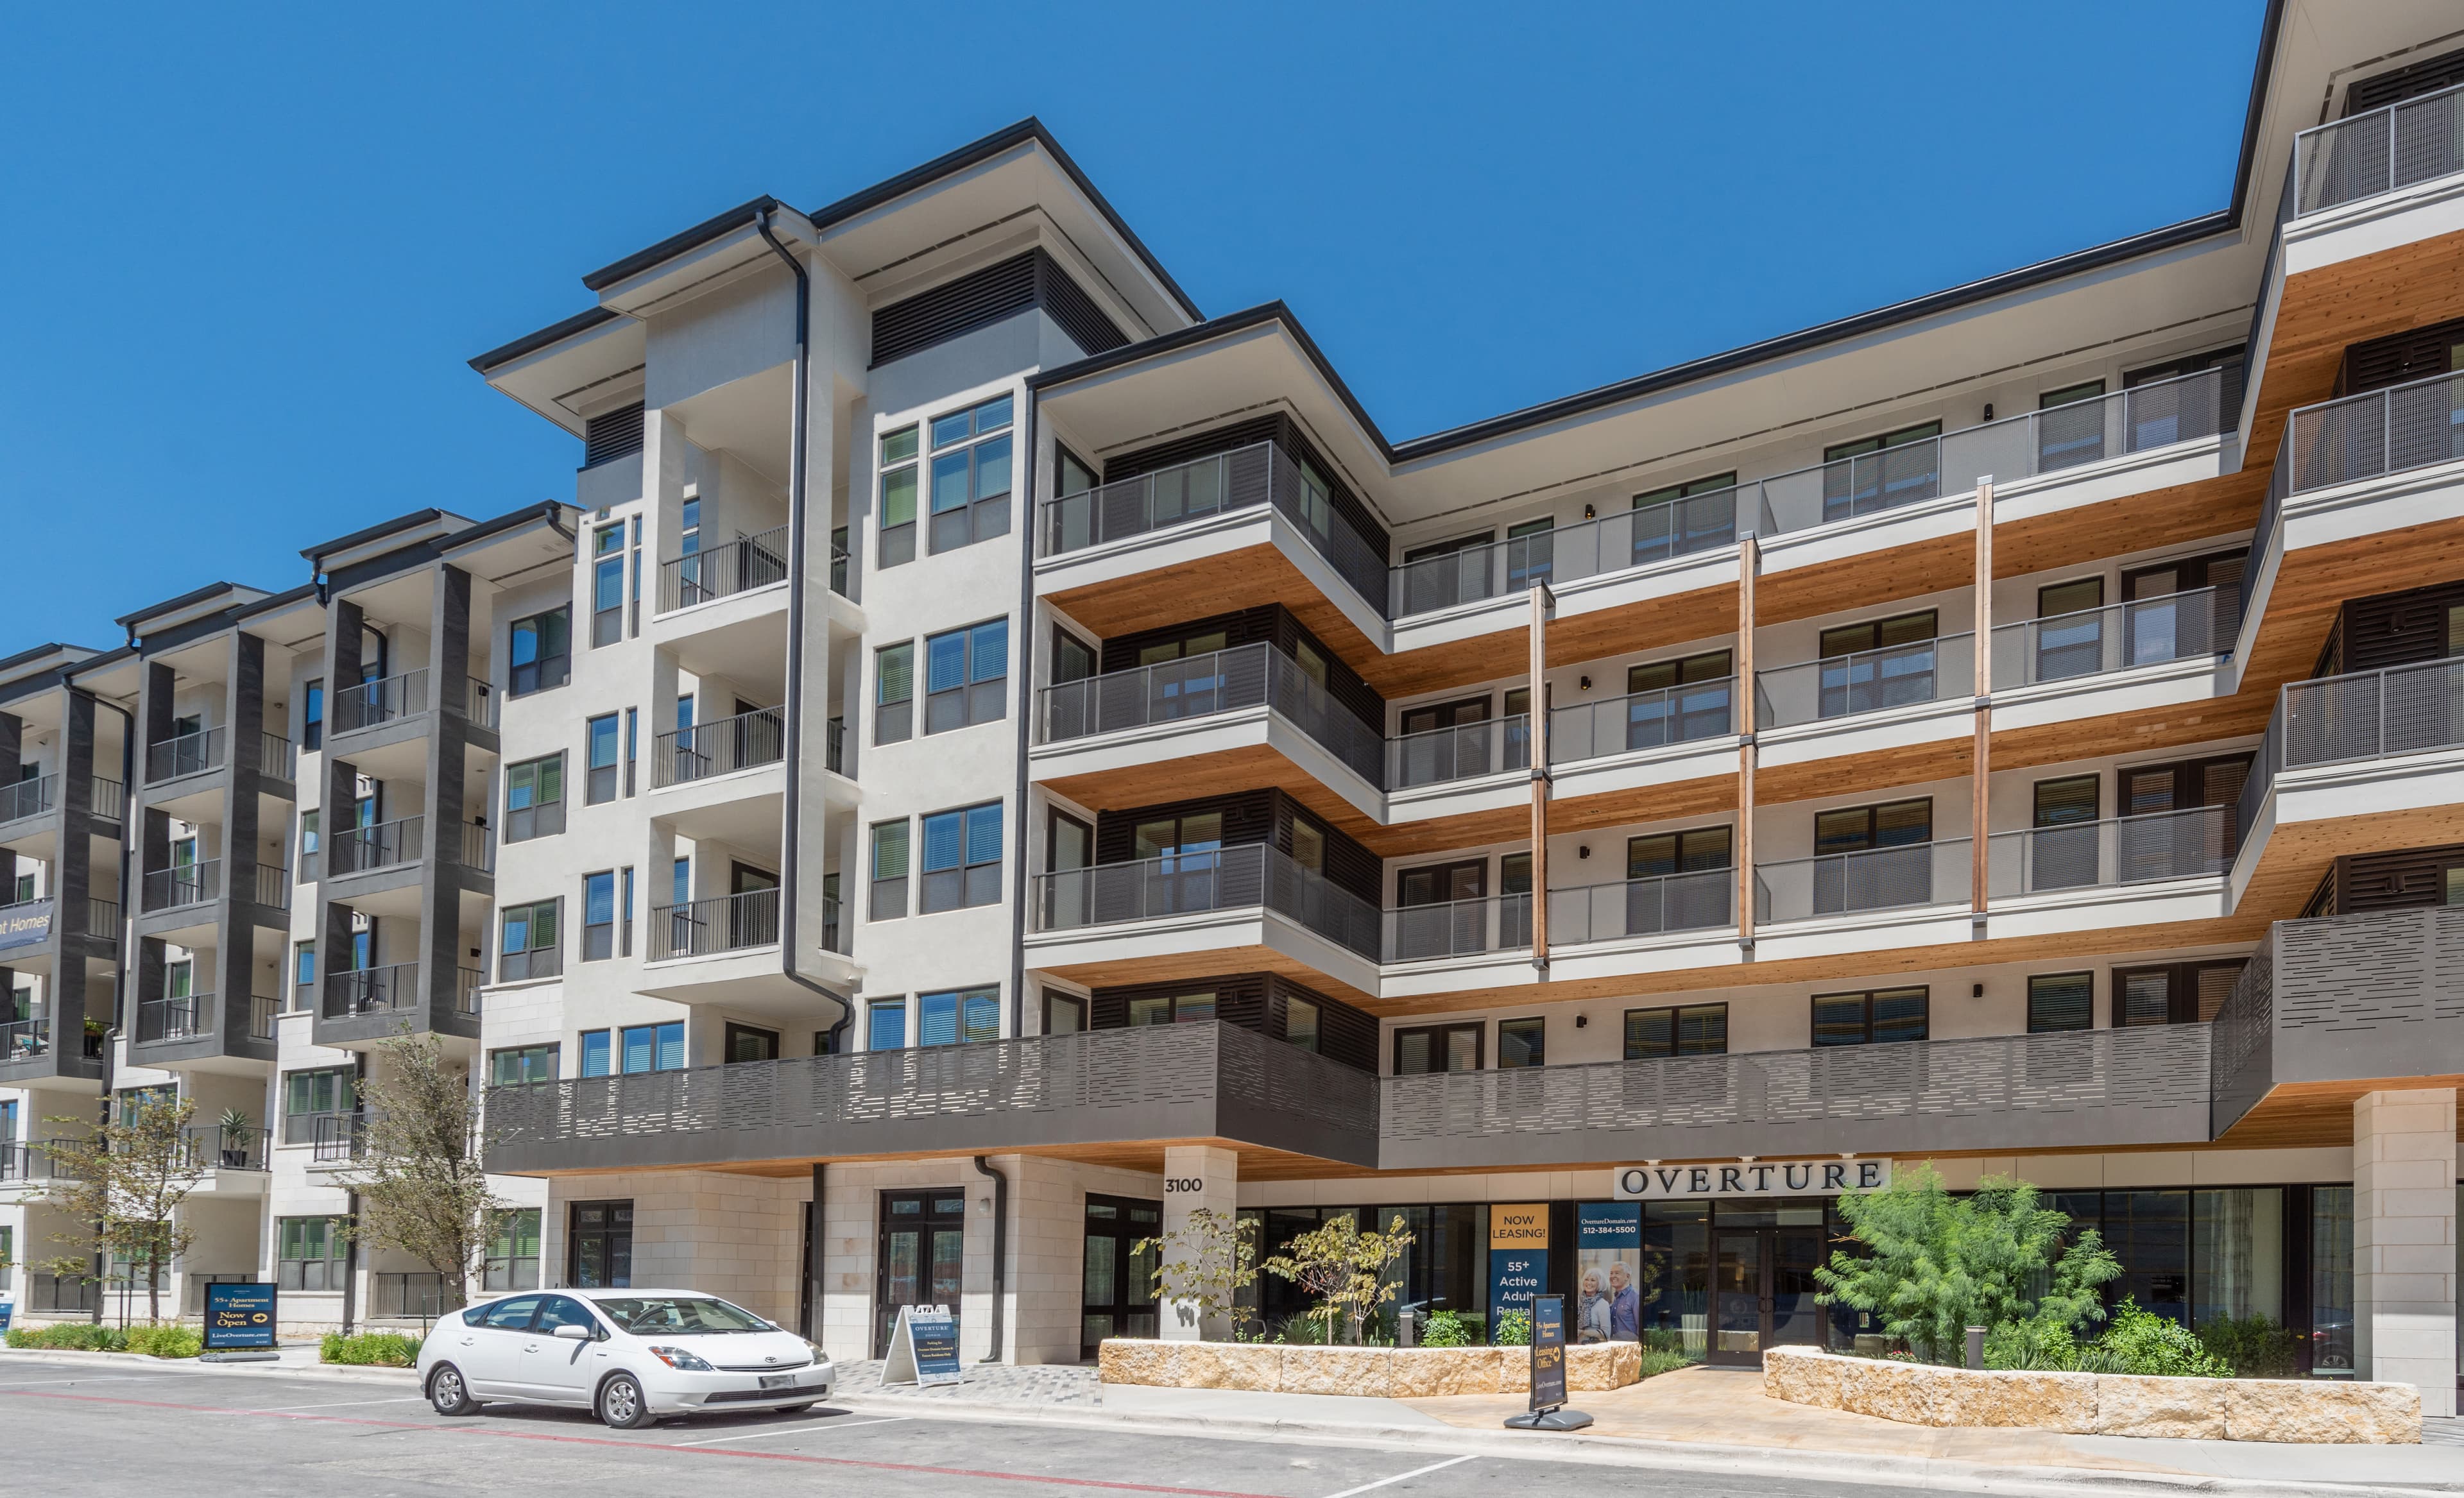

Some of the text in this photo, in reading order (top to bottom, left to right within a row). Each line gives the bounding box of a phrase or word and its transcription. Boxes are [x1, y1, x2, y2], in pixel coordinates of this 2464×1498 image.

[10, 915, 50, 933] Homes
[1621, 1163, 1881, 1194] OVERTURE
[1165, 1178, 1202, 1192] 3100
[1504, 1216, 1534, 1225] NOW
[1493, 1229, 1545, 1238] LEASING!
[1508, 1261, 1529, 1272] 55+
[1500, 1277, 1537, 1286] Active
[1502, 1291, 1534, 1301] Adul
[217, 1319, 247, 1328] Open
[1536, 1346, 1553, 1358] Leasing
[1537, 1358, 1552, 1369] Office
